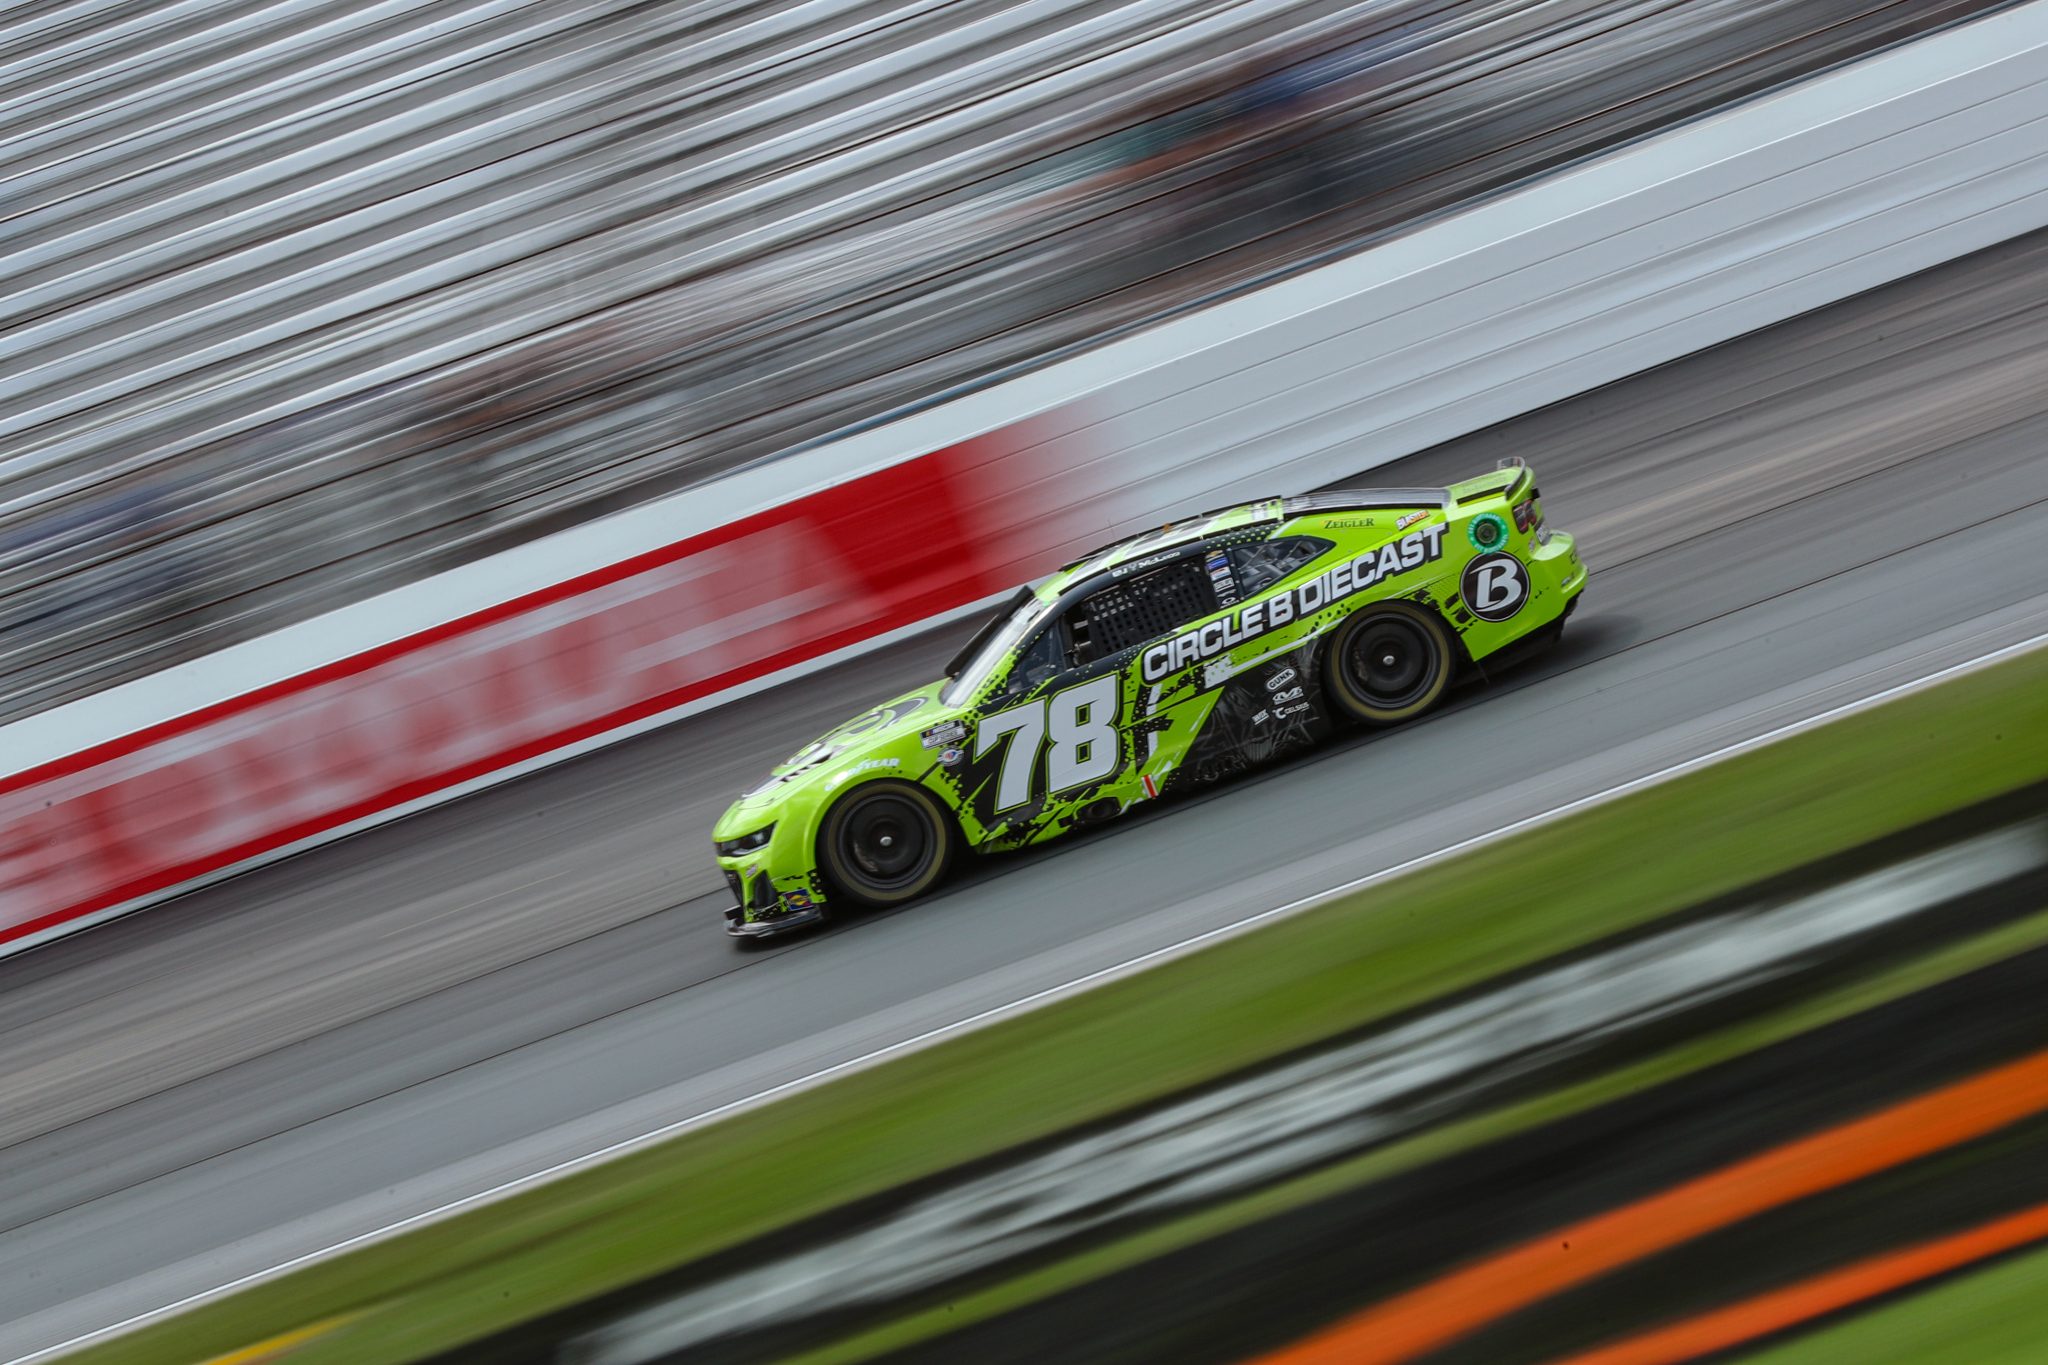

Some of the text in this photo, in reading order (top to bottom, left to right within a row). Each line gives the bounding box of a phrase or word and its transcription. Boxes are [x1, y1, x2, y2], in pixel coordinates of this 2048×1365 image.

[1324, 518, 1375, 529] ZEIGLER
[1143, 603, 1264, 681] CIRCLE
[1269, 591, 1294, 628] B
[1297, 522, 1447, 615] DIECAST
[1269, 669, 1293, 689] GUNK
[975, 673, 1118, 812] 78
